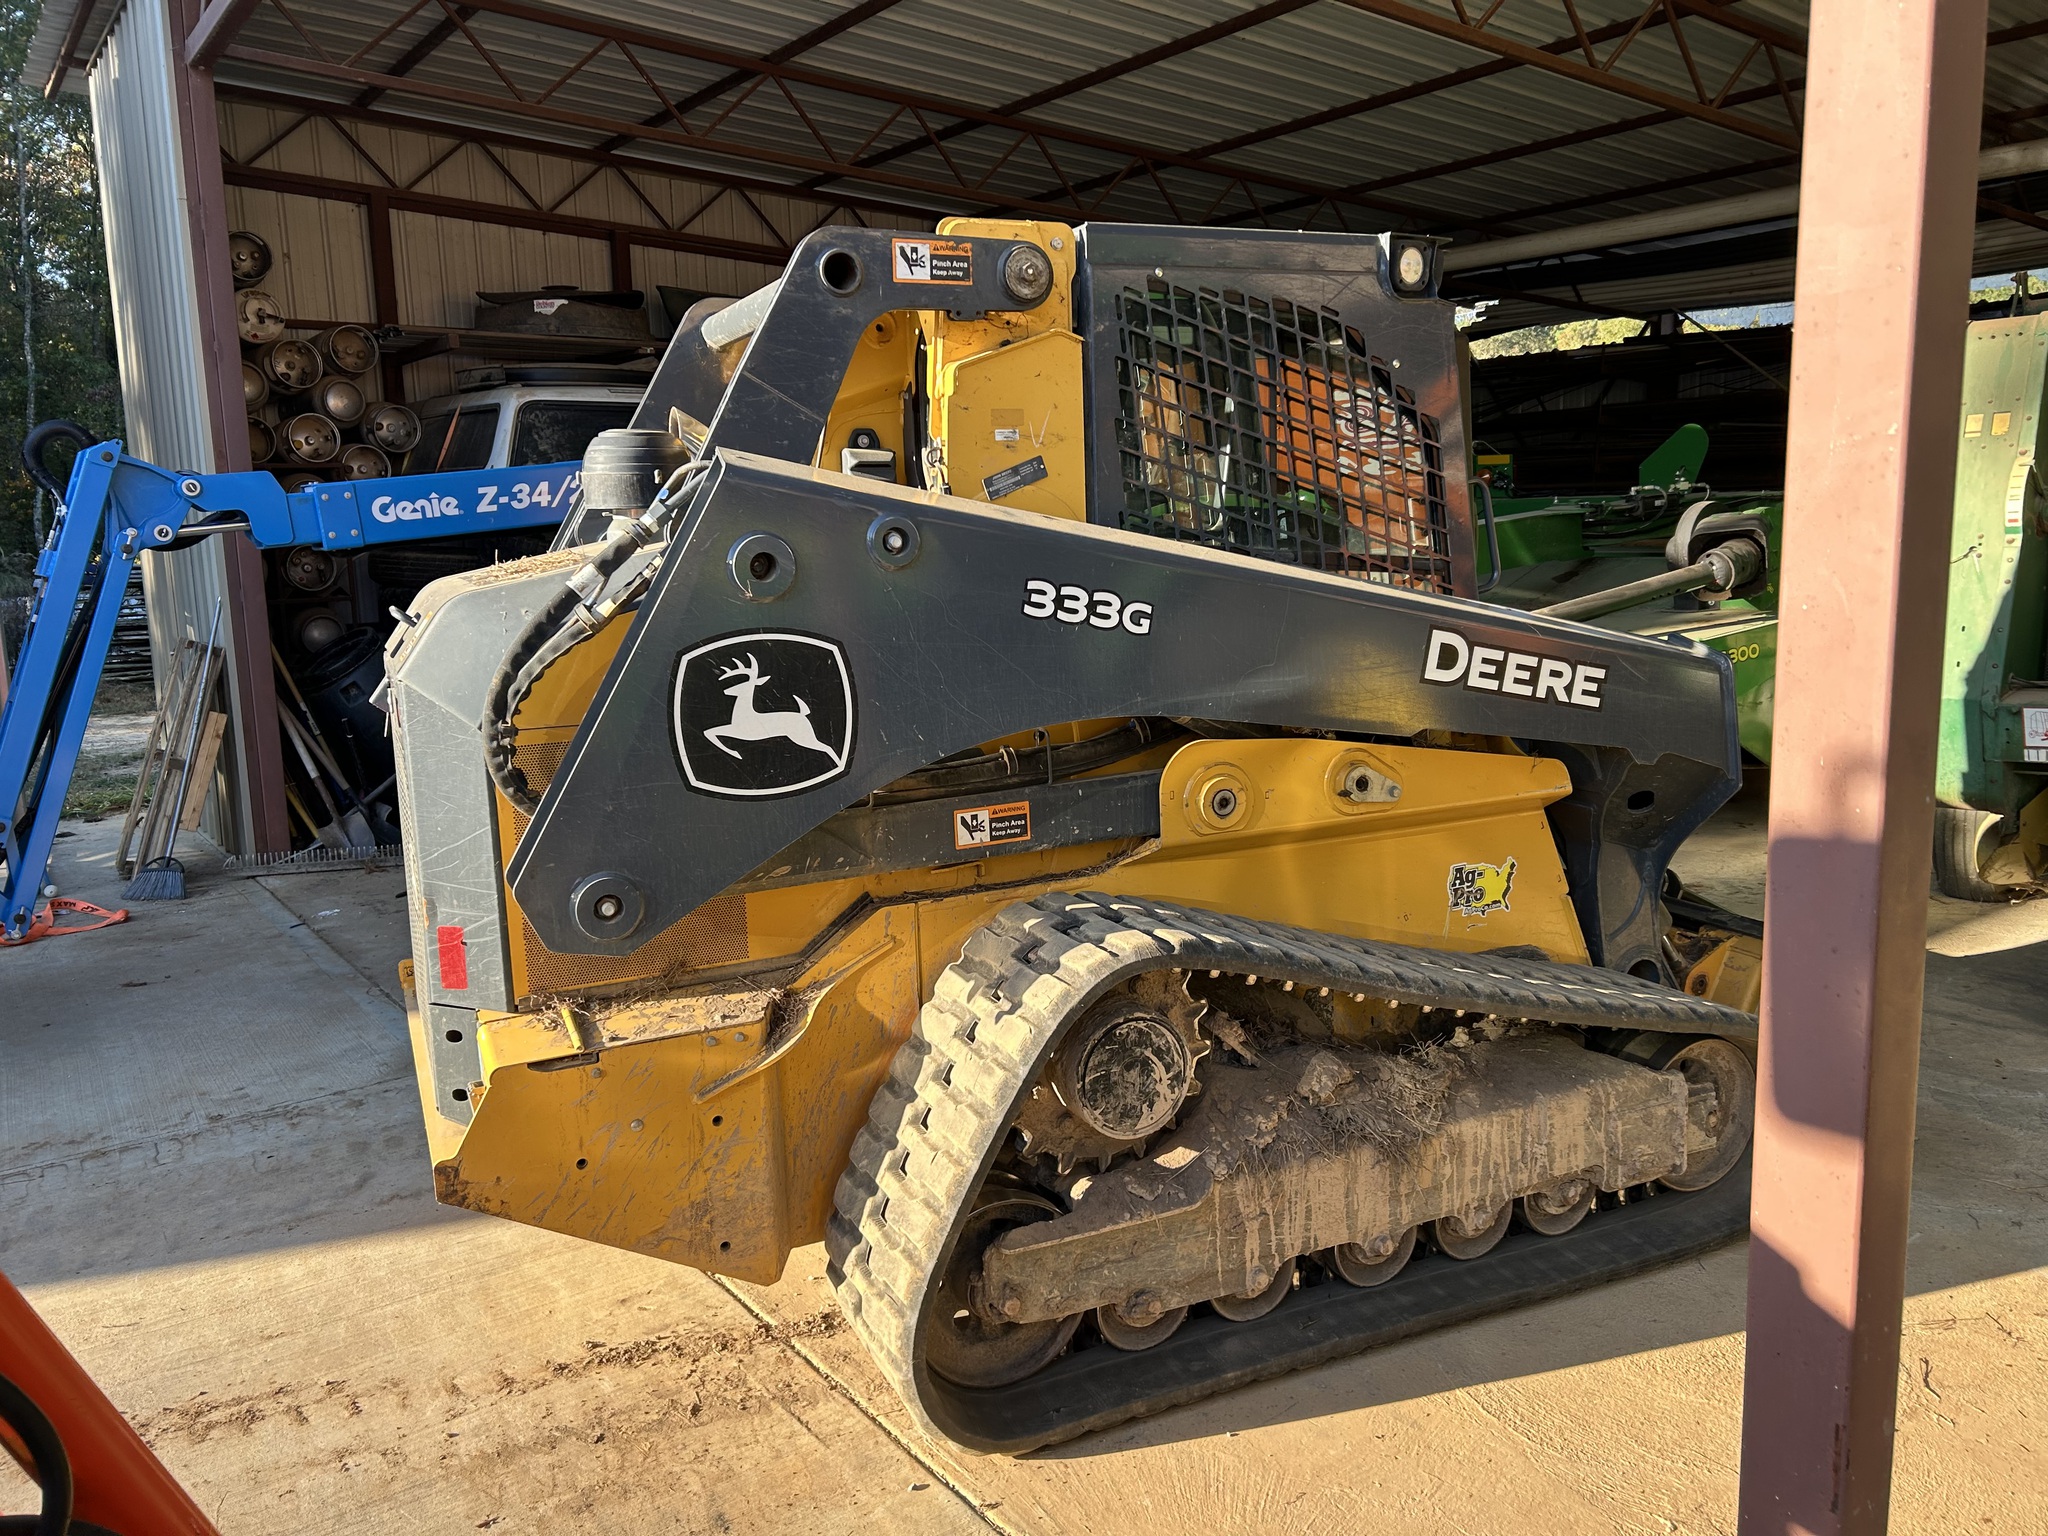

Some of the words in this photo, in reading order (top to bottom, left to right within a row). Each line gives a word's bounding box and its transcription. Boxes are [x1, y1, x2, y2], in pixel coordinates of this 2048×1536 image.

[932, 259, 951, 267] Pinch
[953, 260, 968, 268] Area
[371, 491, 460, 523] Genie
[1022, 579, 1153, 635] 333G
[1721, 643, 1760, 664] 300
[1424, 629, 1607, 708] DEERE
[997, 805, 1026, 814] WARNING
[991, 821, 1009, 829] Pinch
[1010, 819, 1025, 827] Area
[1451, 866, 1485, 889] Ag-
[1452, 887, 1485, 908] Pro
